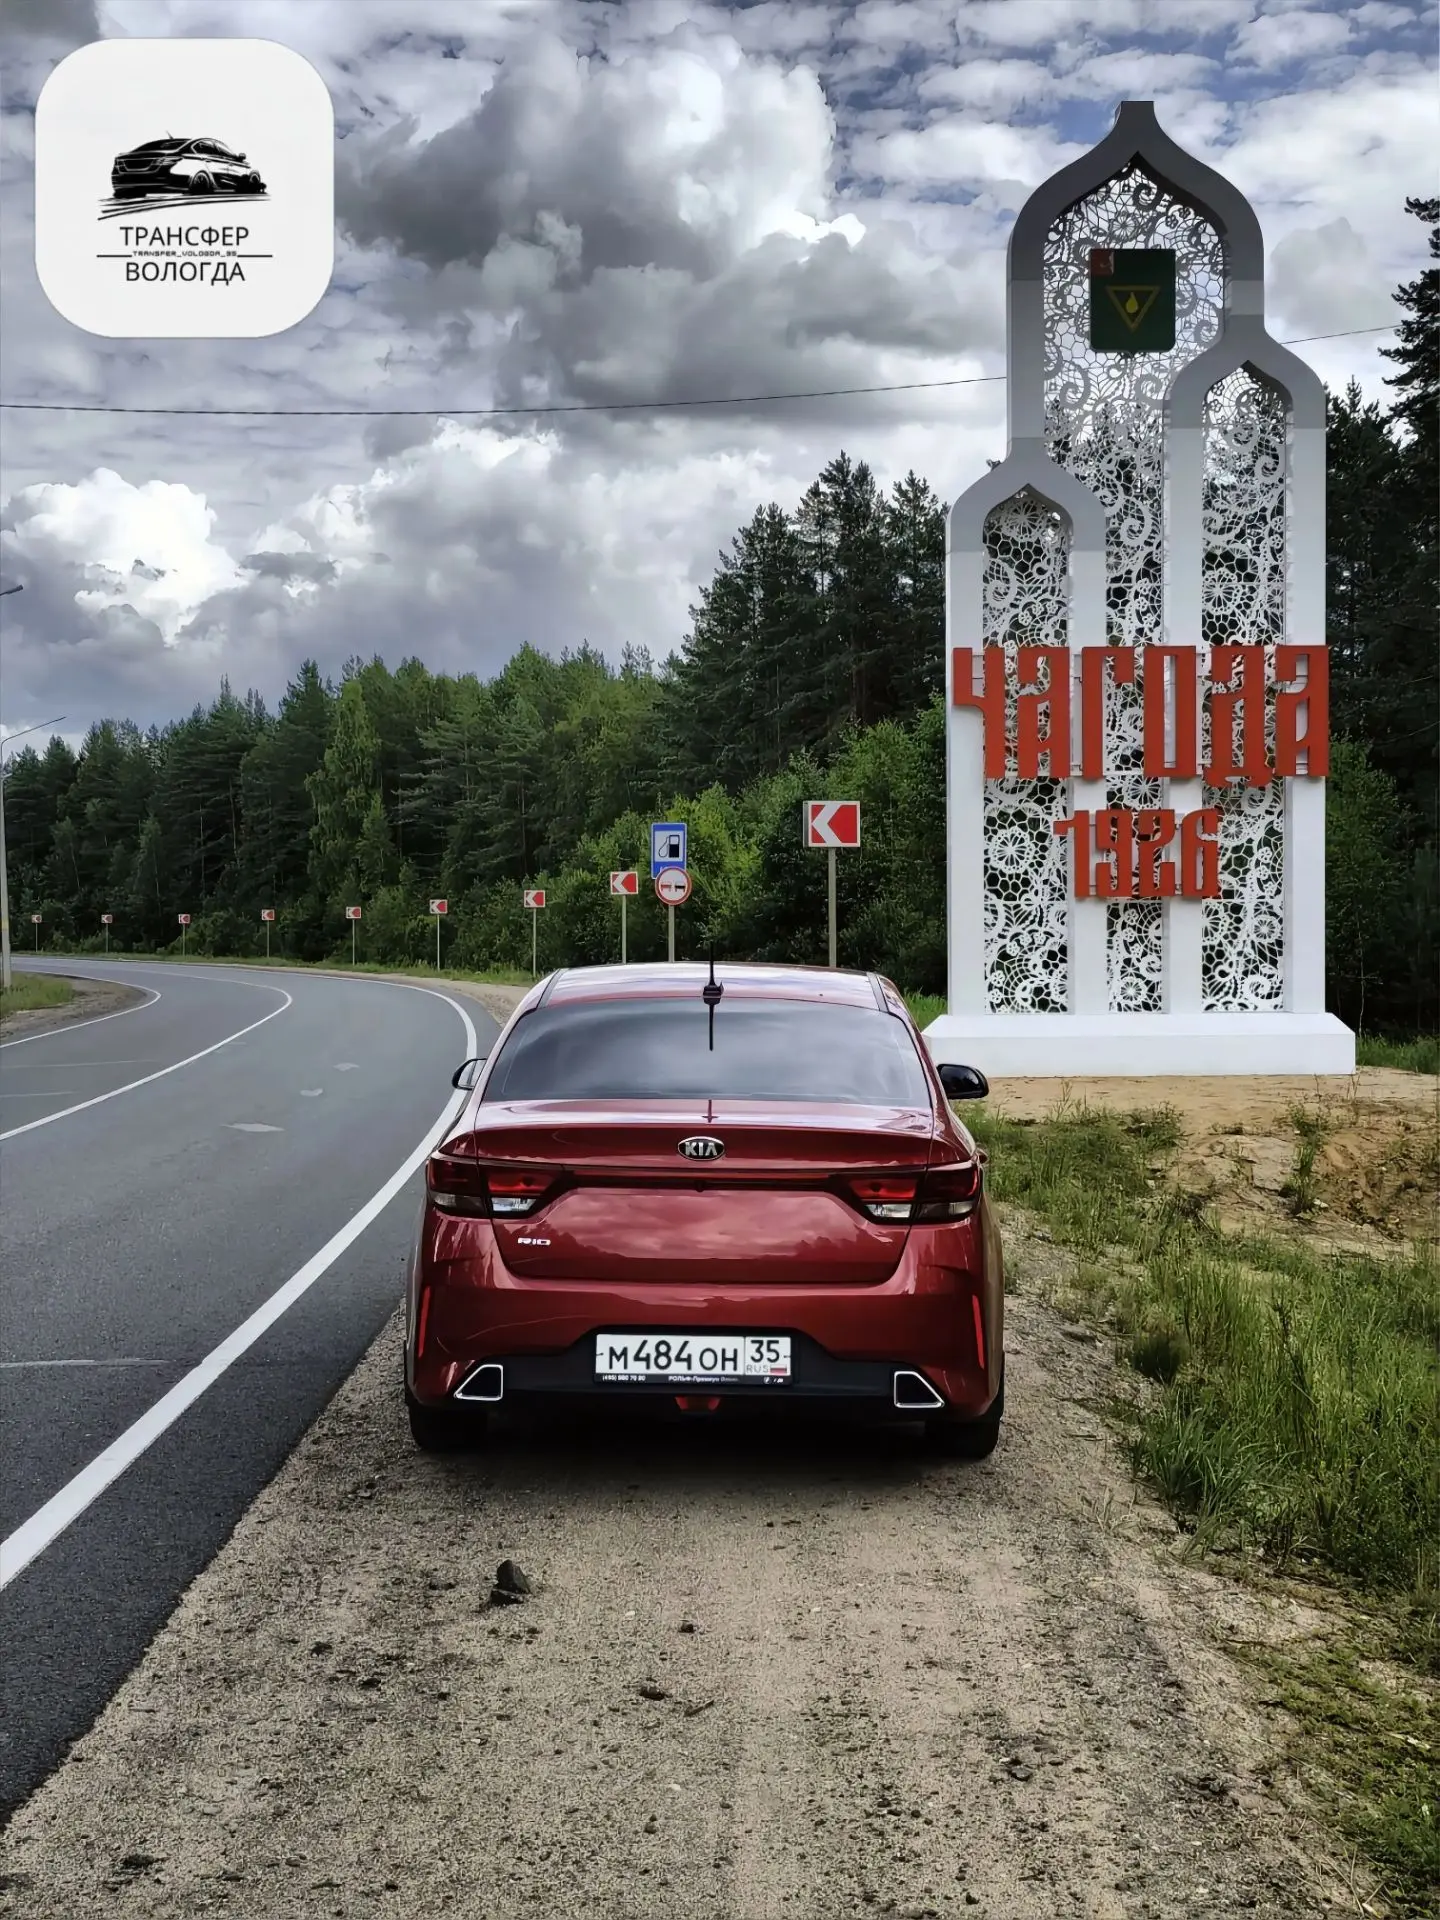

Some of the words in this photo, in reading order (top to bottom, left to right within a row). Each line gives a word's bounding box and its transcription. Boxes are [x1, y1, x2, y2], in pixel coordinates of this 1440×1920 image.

[953, 644, 1329, 787] ЧАГОДА
[1053, 808, 1222, 900] 1926
[684, 1141, 719, 1157] KIA
[517, 1236, 551, 1246] RIO
[750, 1339, 780, 1363] 35
[746, 1364, 768, 1374] RUS
